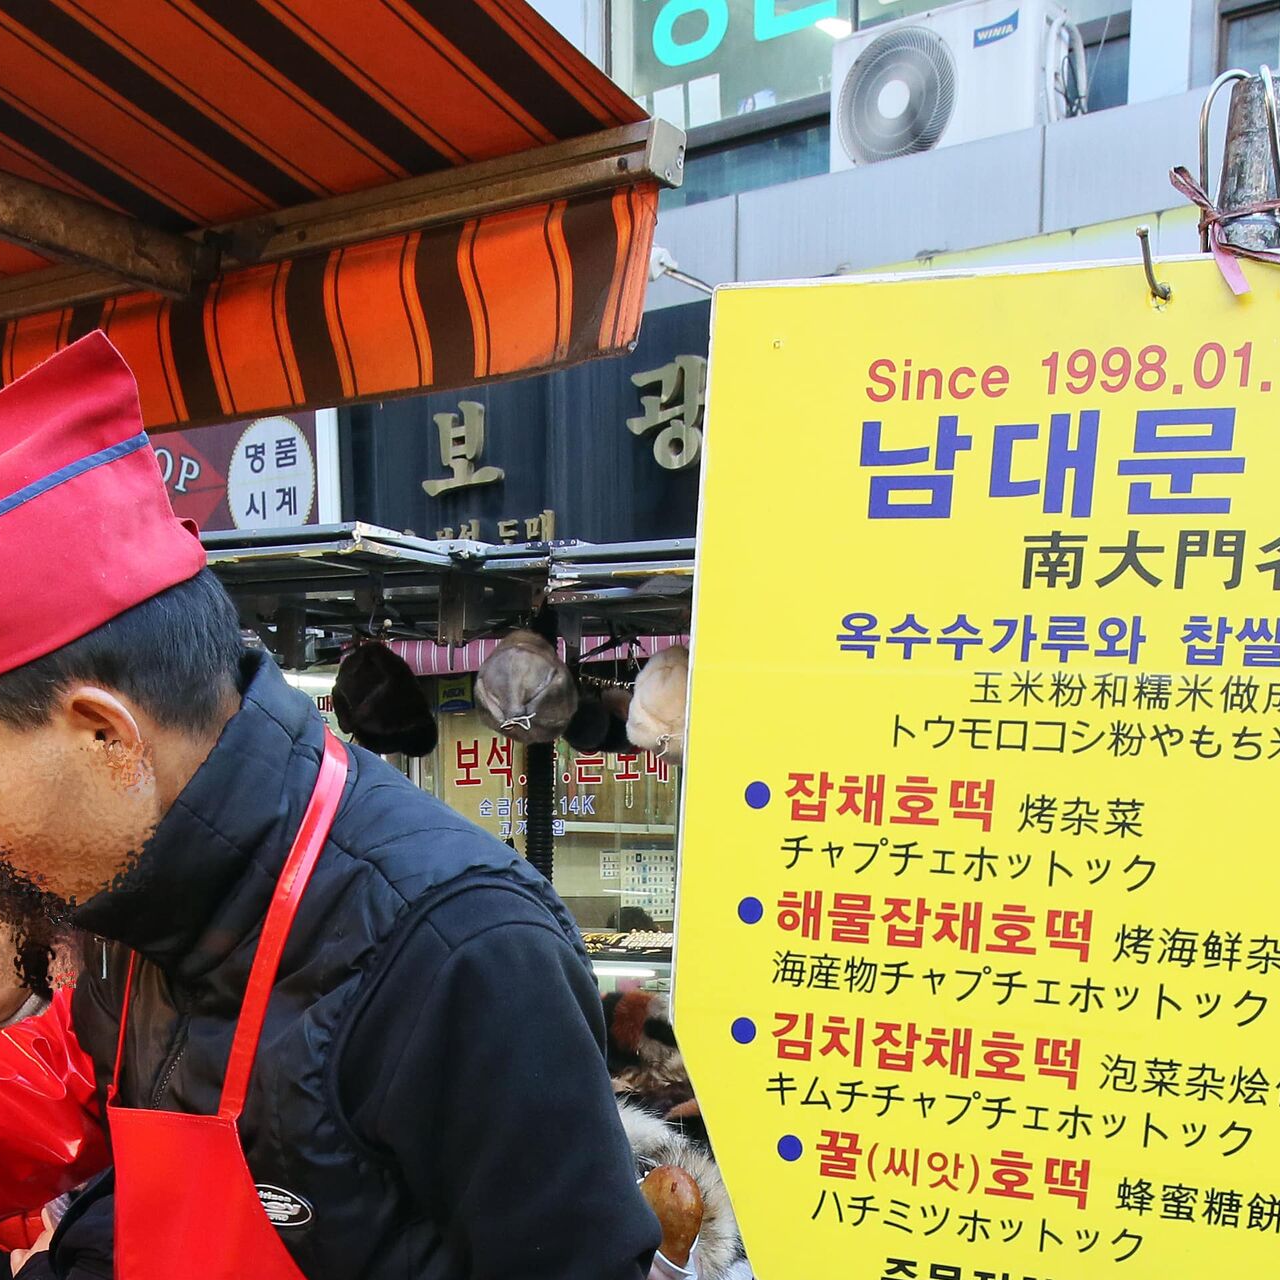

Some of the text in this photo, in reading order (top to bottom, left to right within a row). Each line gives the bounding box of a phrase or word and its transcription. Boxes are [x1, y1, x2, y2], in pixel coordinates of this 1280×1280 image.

[976, 23, 1015, 42] WINIA
[866, 357, 1010, 403] Since
[245, 436, 298, 474] 명품
[859, 407, 1246, 521] 남대문
[246, 486, 298, 521] 시계
[836, 611, 1147, 666] 옥수수가루와
[784, 771, 996, 834] 잡채호떡
[1018, 793, 1146, 839] 烤杂菜
[779, 834, 1159, 894] チャプチェホットック
[776, 890, 1095, 965] 해물잡채호떡
[770, 949, 1270, 1027] 海産物チャプチェホットック
[769, 1010, 1083, 1092] 김치잡채호떡
[764, 1069, 1255, 1159] キムチチャプチェホットック
[814, 1128, 1092, 1210] 꿀(씨앗)호떡
[809, 1188, 1146, 1263] ハチミツホットック
